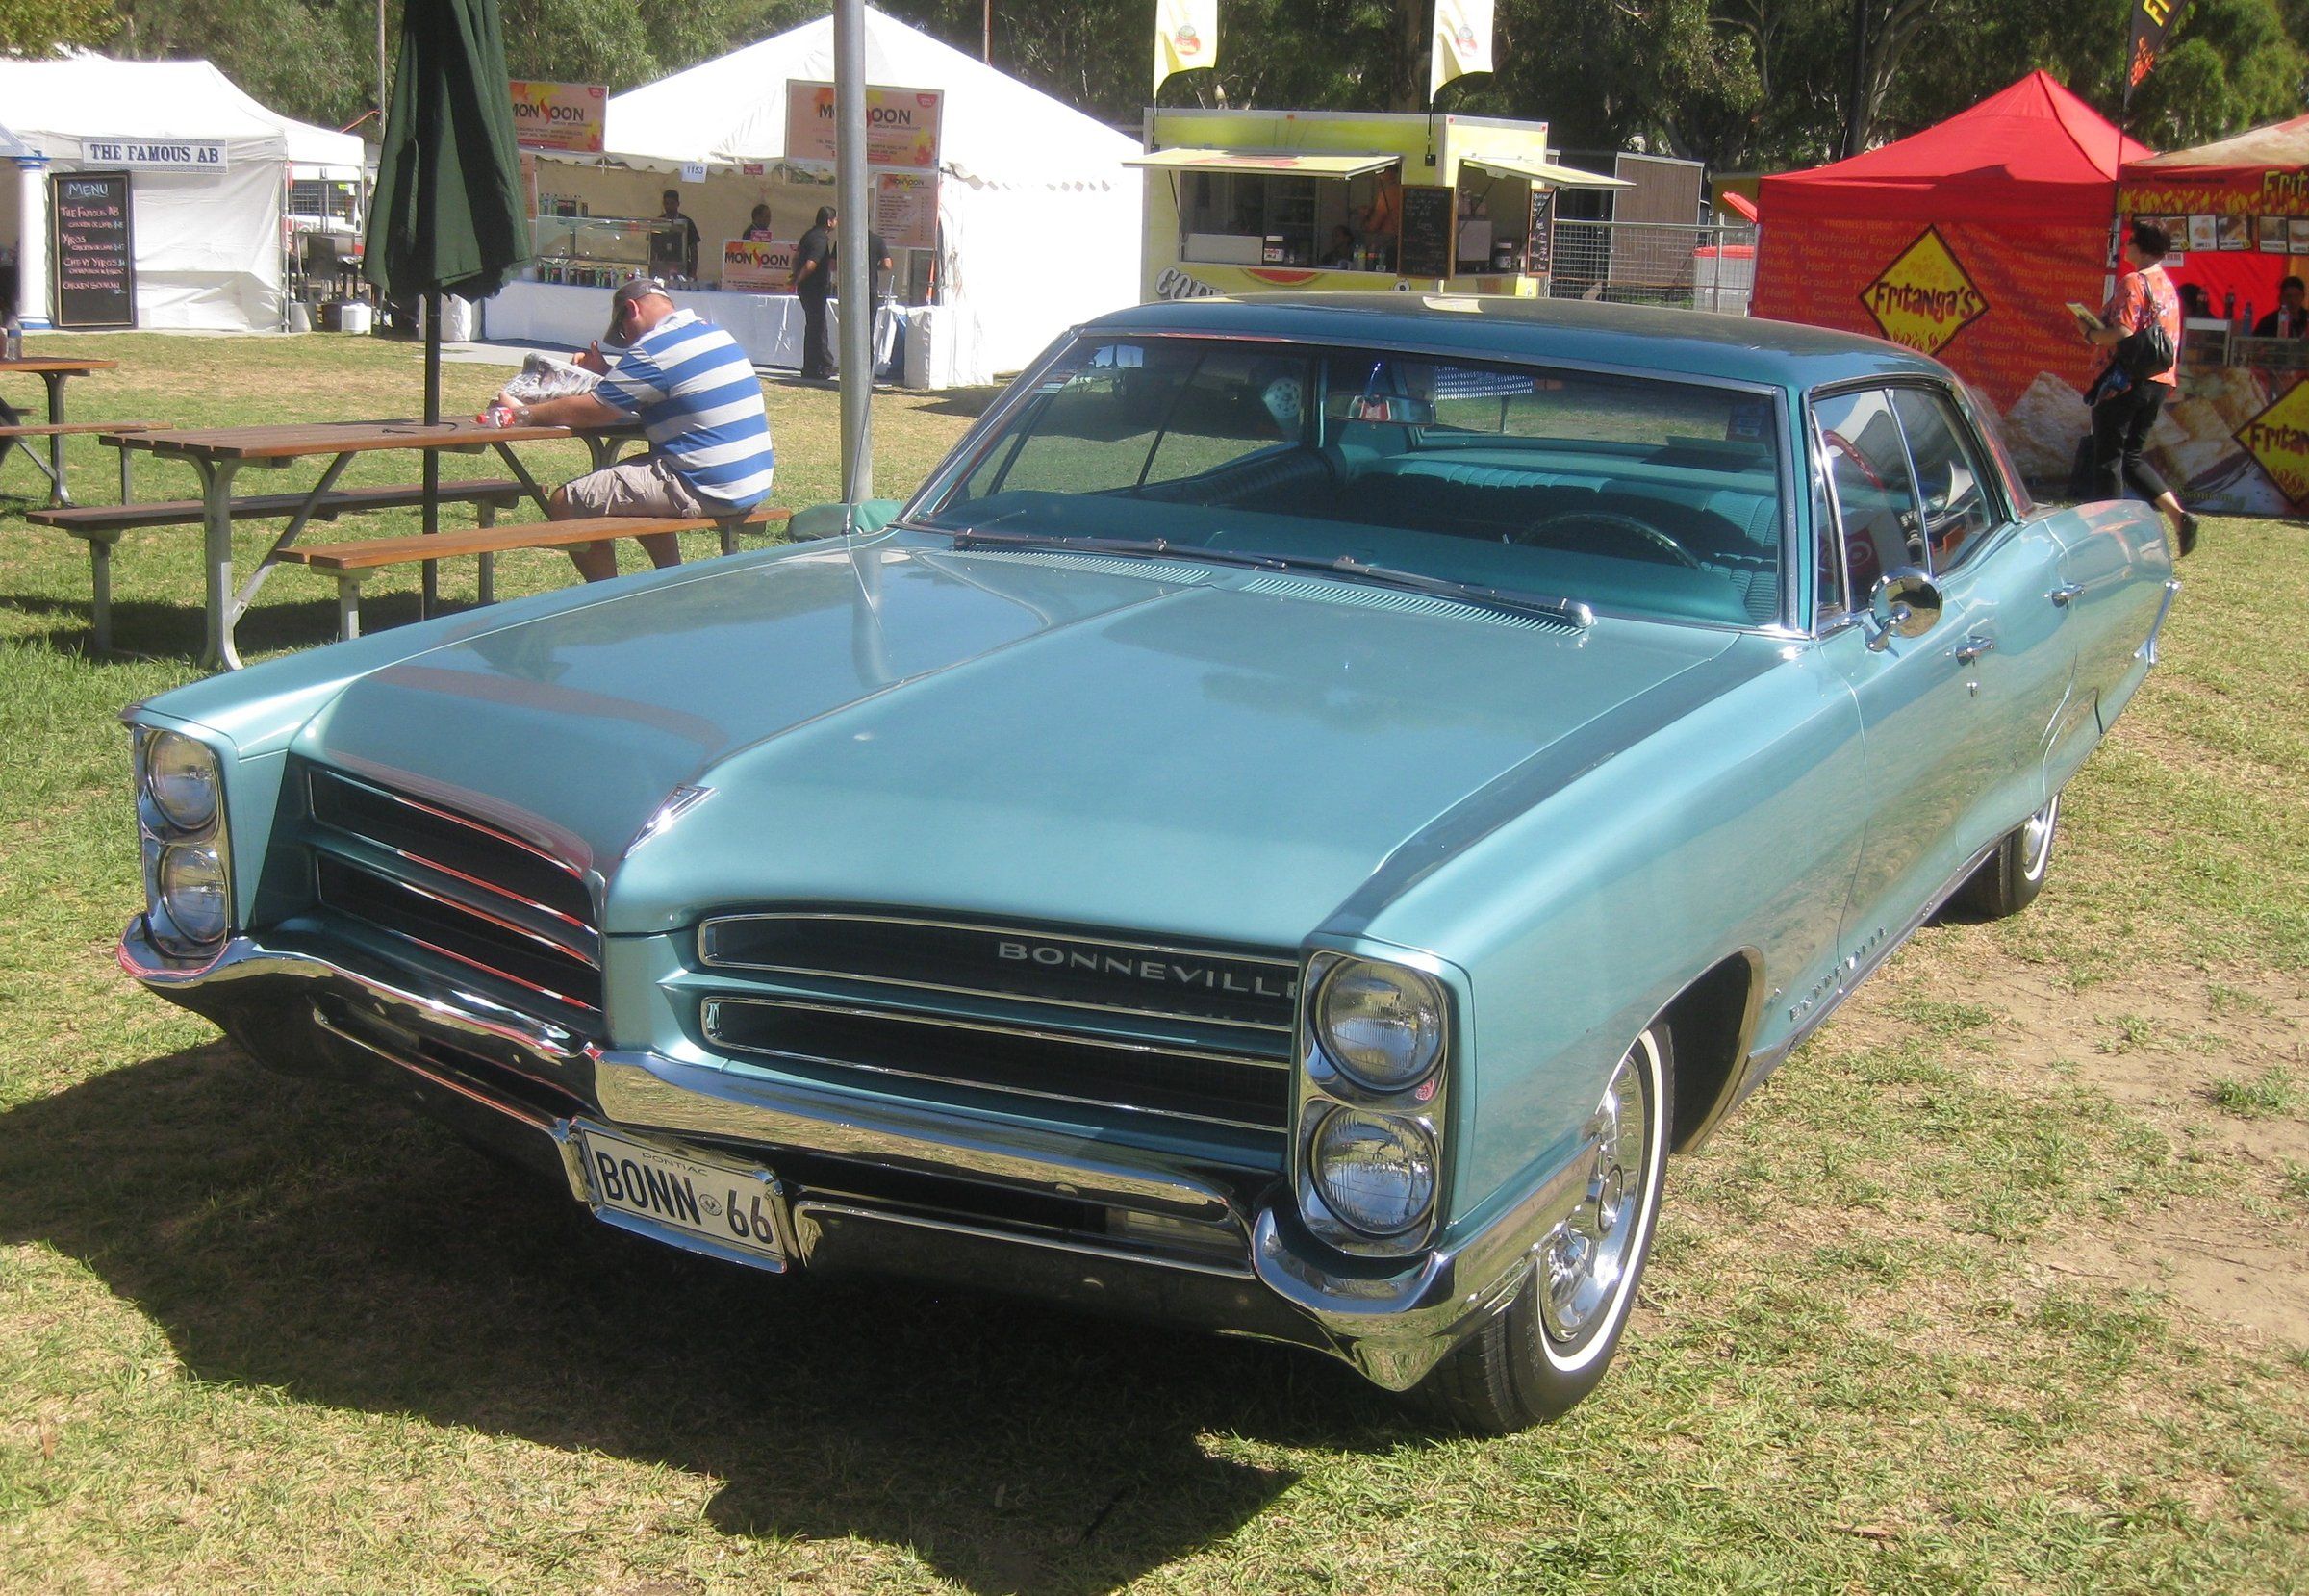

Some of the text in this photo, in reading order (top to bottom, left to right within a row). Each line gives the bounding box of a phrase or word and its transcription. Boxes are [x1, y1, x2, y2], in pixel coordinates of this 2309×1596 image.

[90, 144, 218, 163] THE FAMOUS AB
[686, 165, 704, 175] 1153
[68, 183, 109, 198] MENU
[61, 206, 76, 218] THE
[77, 206, 107, 218] FAMOUS
[1763, 228, 1807, 241] Yummy!
[1812, 230, 1861, 244] Disfruta!
[724, 247, 790, 269] MONSOON
[1763, 244, 1794, 256] Enjoy!
[1800, 244, 1828, 257] Hola!
[1838, 247, 1869, 262] Hello!
[1765, 258, 1794, 269] Hello!
[1805, 261, 1834, 272] Hola!
[1760, 272, 1797, 285] Thanks!
[1800, 275, 1843, 289] Gracias!
[1764, 288, 1796, 299] Hello!
[1966, 336, 2014, 350] Gracias!
[2023, 340, 2067, 355] Thanks!
[1964, 350, 2010, 367] Gracias!
[2021, 356, 2067, 370] Thanks!
[642, 1152, 709, 1178] PONTIAC
[596, 1151, 774, 1245] BONN 66
